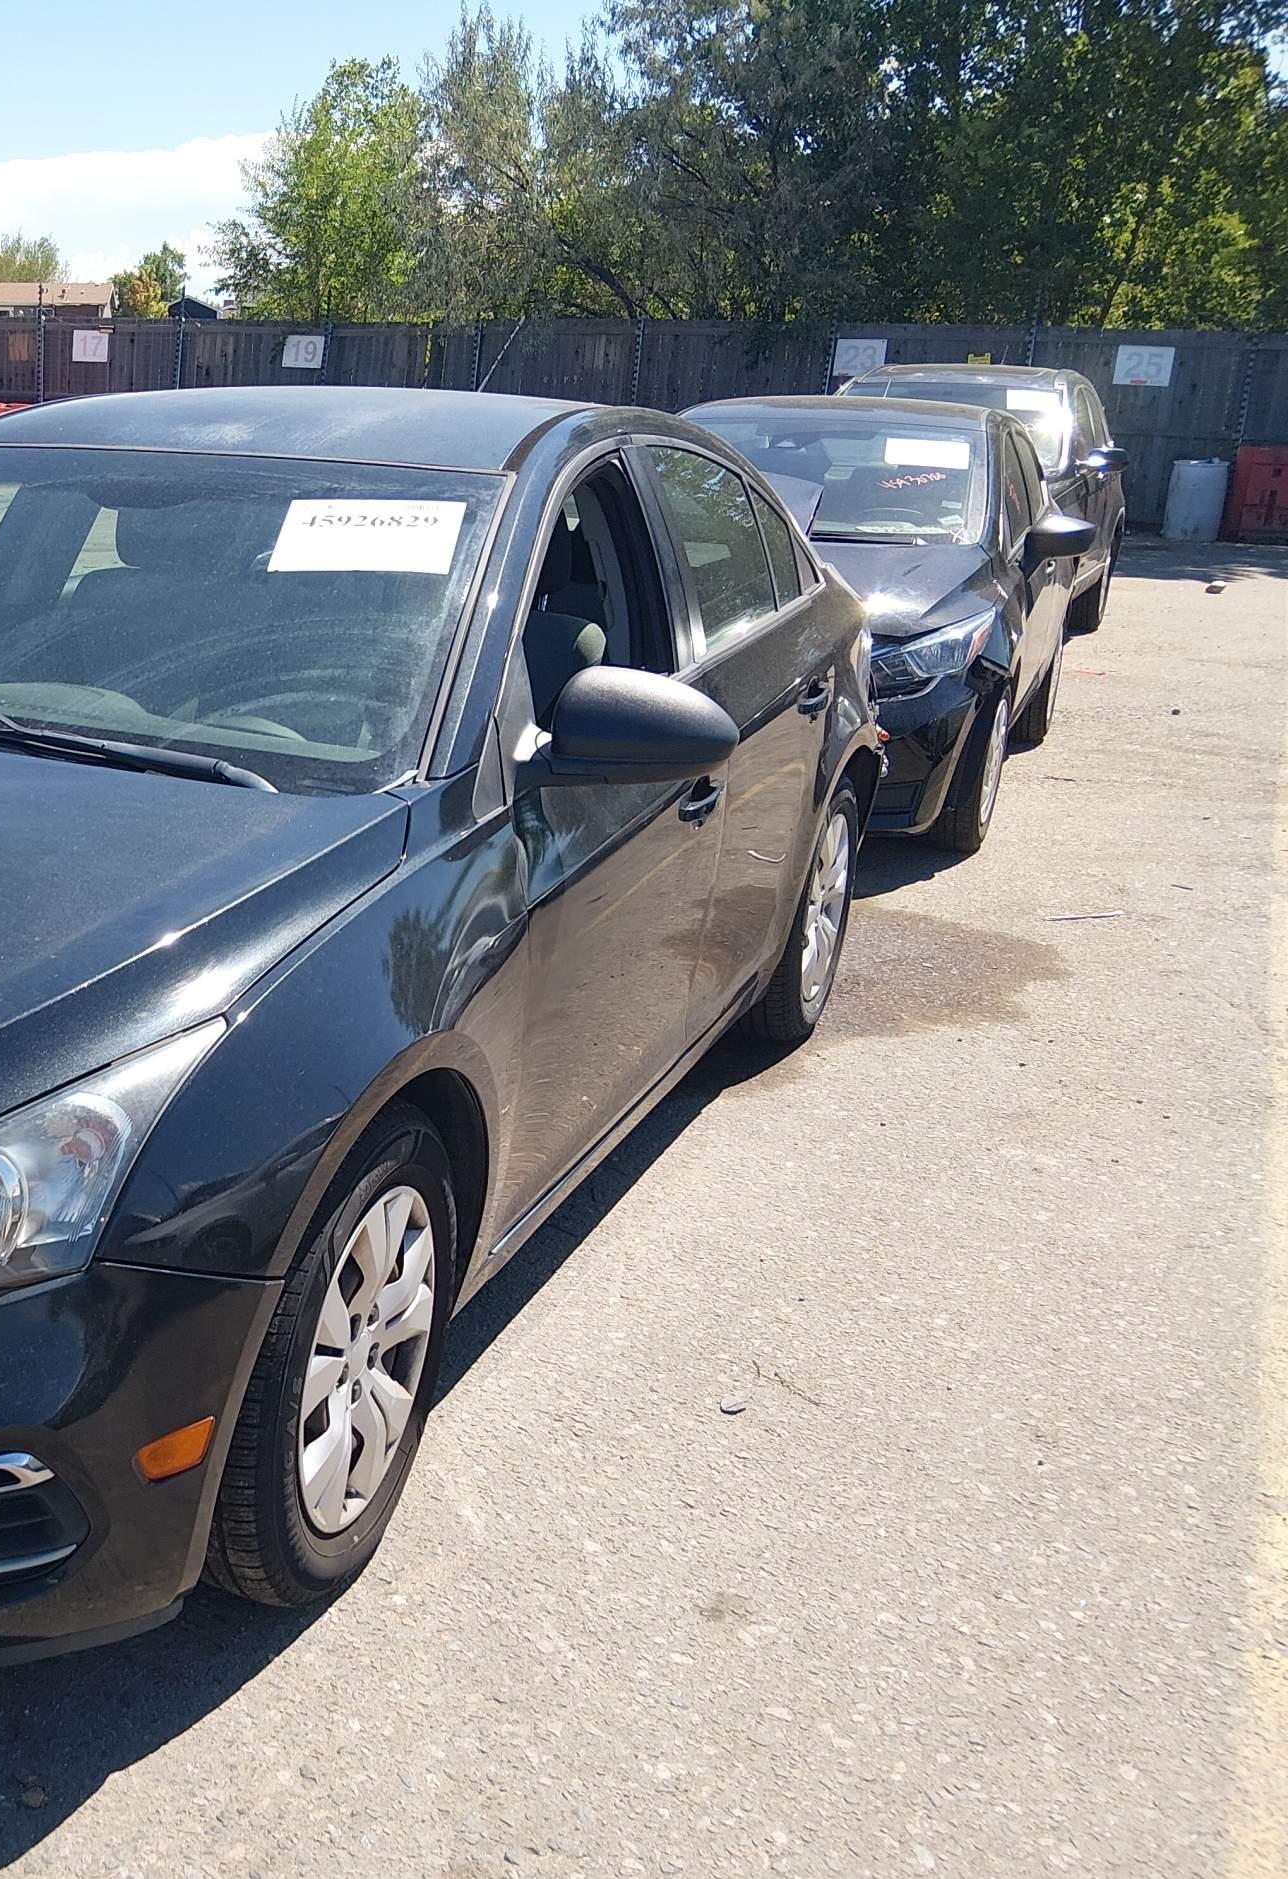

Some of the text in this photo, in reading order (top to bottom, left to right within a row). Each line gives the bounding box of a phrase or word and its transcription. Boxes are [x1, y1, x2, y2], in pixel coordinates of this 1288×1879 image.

[80, 335, 103, 357] 17
[292, 340, 317, 363] 19
[844, 344, 878, 371] 23
[1124, 351, 1163, 379] 25
[302, 515, 439, 528] 45926829
